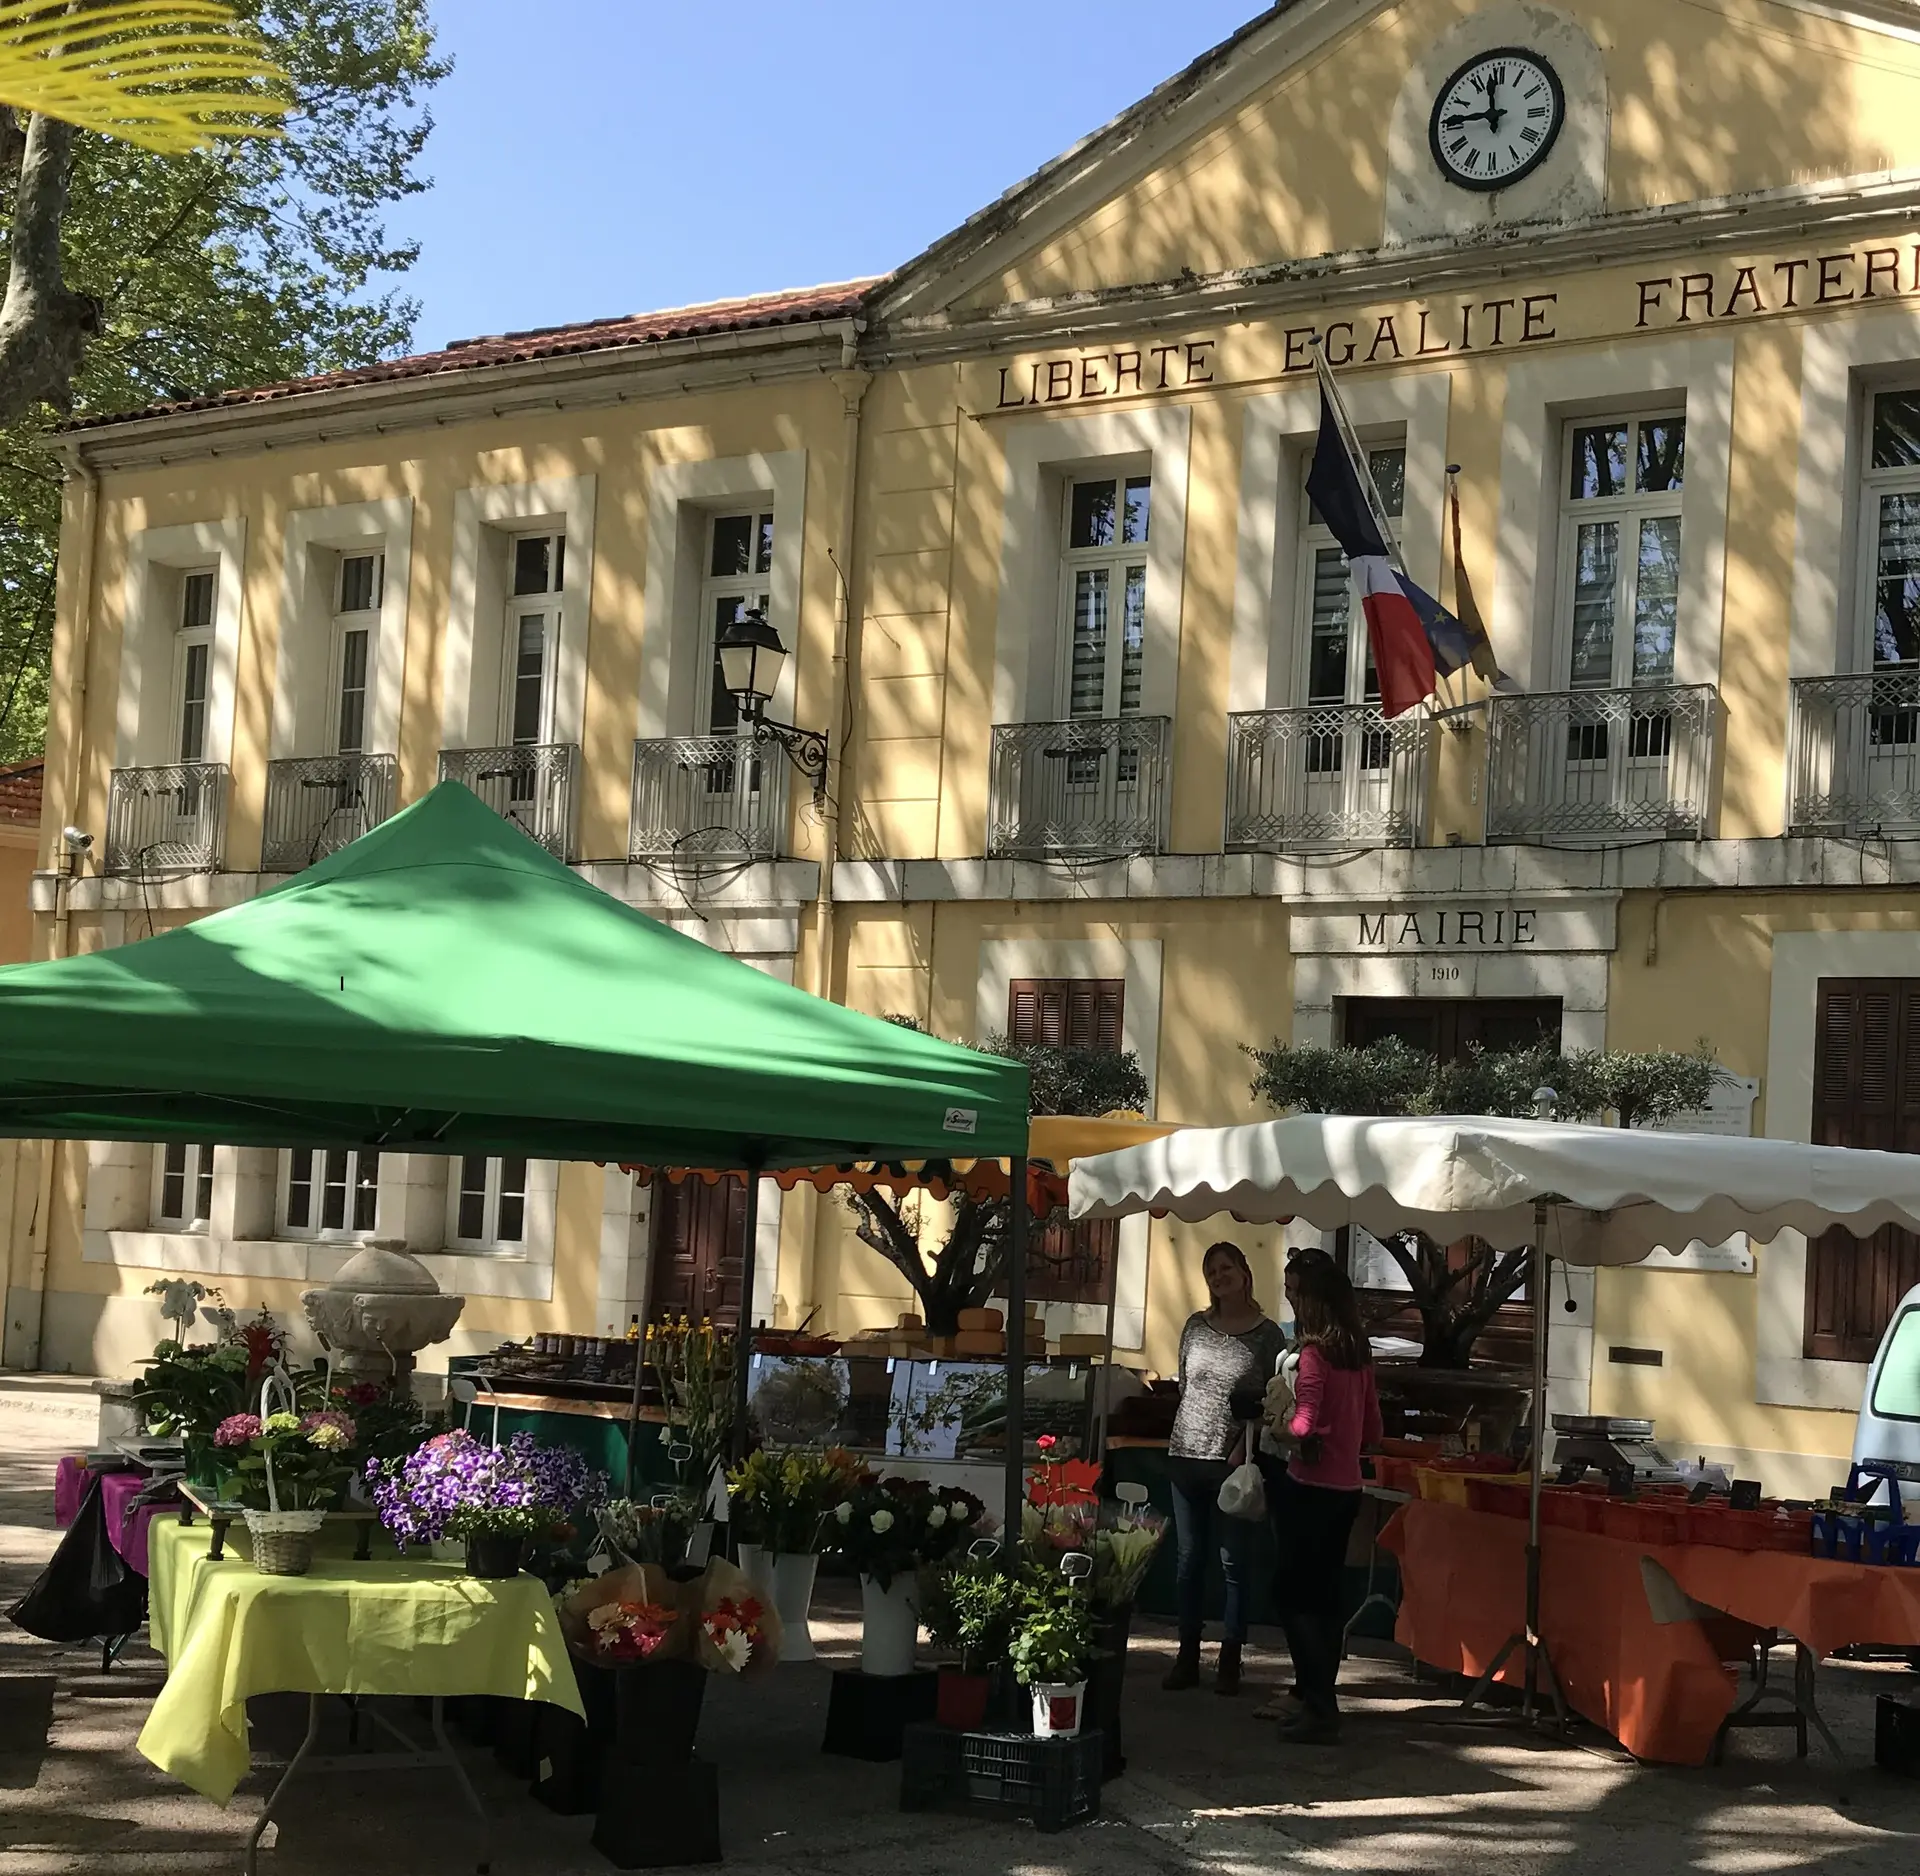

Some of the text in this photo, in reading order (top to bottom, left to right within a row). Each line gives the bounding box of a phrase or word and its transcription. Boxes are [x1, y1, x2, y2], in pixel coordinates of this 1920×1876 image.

[996, 244, 1920, 409] LIBERTE EGALITE FRATER
[1357, 909, 1537, 946] MAIRIE
[1431, 967, 1460, 981] 1910
